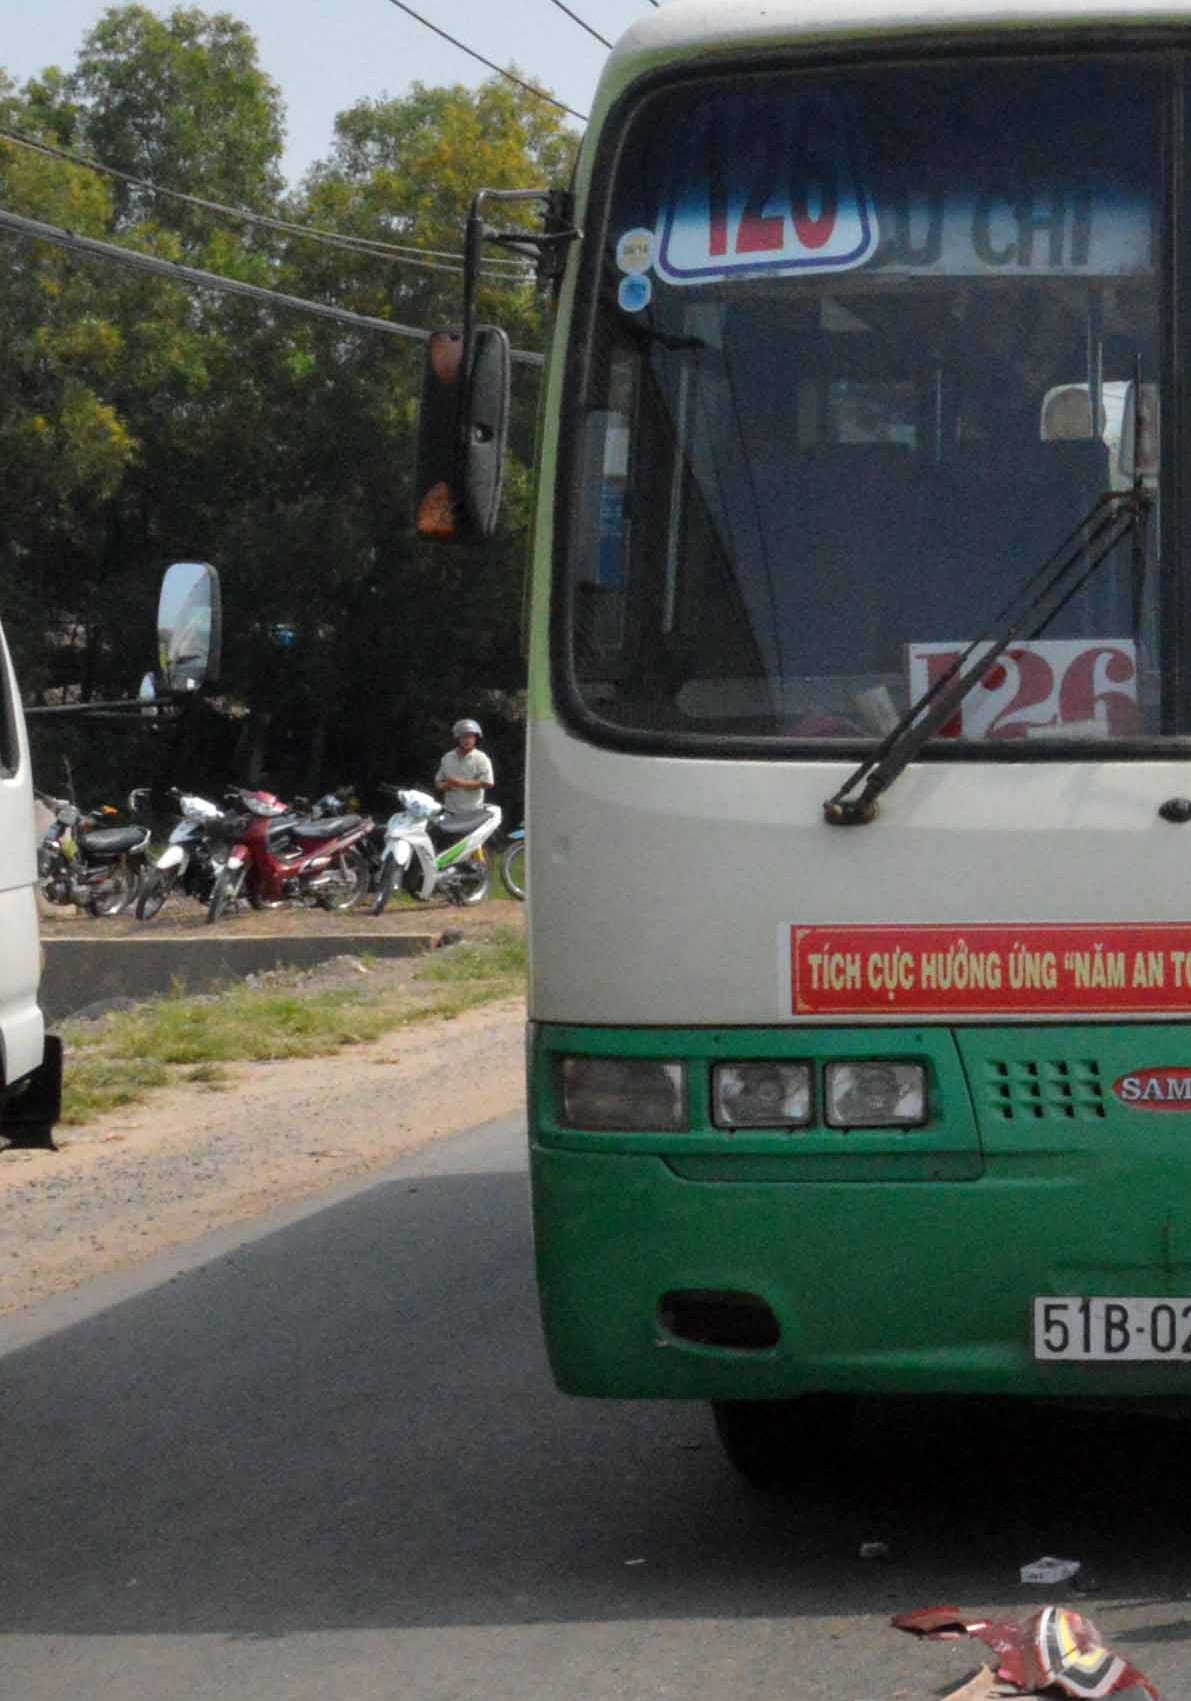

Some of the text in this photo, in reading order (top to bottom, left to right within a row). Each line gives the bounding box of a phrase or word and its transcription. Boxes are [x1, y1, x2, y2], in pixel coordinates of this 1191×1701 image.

[808, 943, 861, 989] TÍCH
[867, 945, 914, 1000] CỰC
[921, 938, 1000, 988] HƯỞNG
[1009, 942, 1057, 988] ỨNG
[1132, 951, 1164, 988] AN
